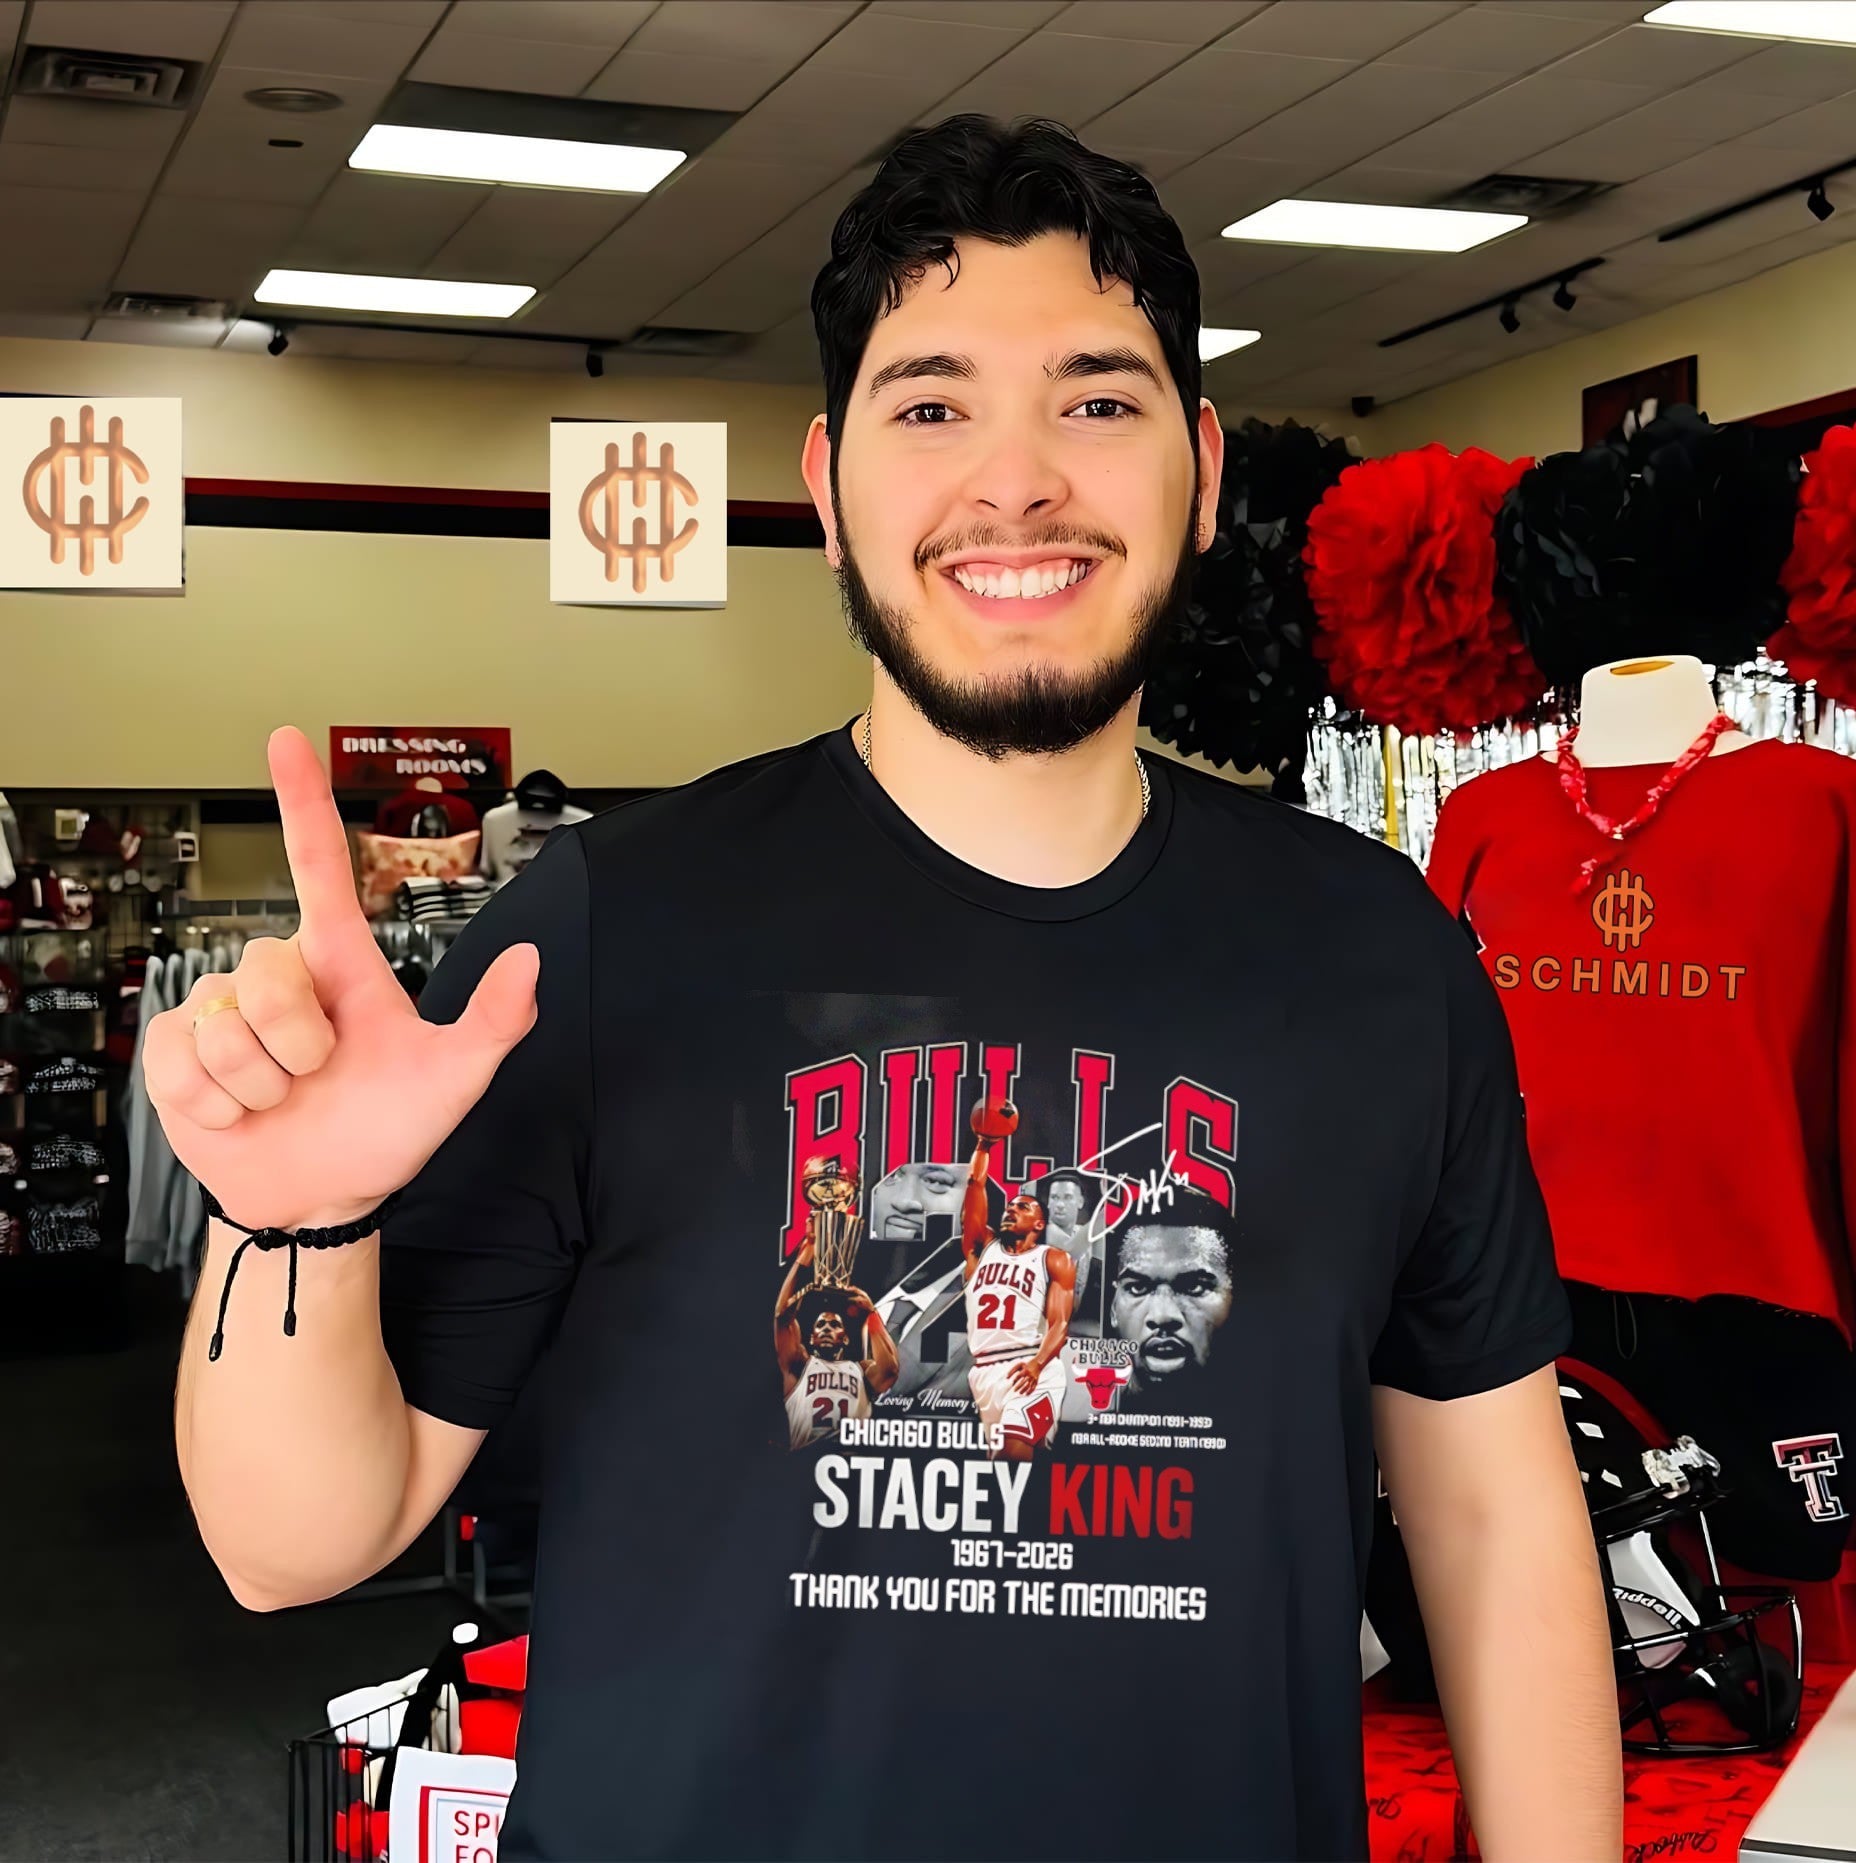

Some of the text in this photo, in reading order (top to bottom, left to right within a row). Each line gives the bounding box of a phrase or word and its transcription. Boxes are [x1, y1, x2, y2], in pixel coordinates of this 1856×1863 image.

[342, 737, 467, 753] DRESSING
[395, 758, 487, 775] ROOMS
[1494, 953, 1747, 1000] SCHMIDT
[779, 1041, 1239, 1266] BULLS
[972, 1262, 1036, 1298] BULLS
[976, 1293, 1017, 1330] 21
[1069, 1338, 1139, 1354] CHICAGO
[1078, 1353, 1127, 1366] BULLS
[805, 1371, 859, 1399] BULLS
[917, 1388, 969, 1414] Memory
[812, 1397, 850, 1429] 21
[840, 1418, 1005, 1451] CHICAGO BULLS
[812, 1454, 1195, 1540] STACEY KING
[950, 1538, 1074, 1571] 1967-2026
[790, 1572, 1207, 1622] THANK YOU FOR THE MEMORIES
